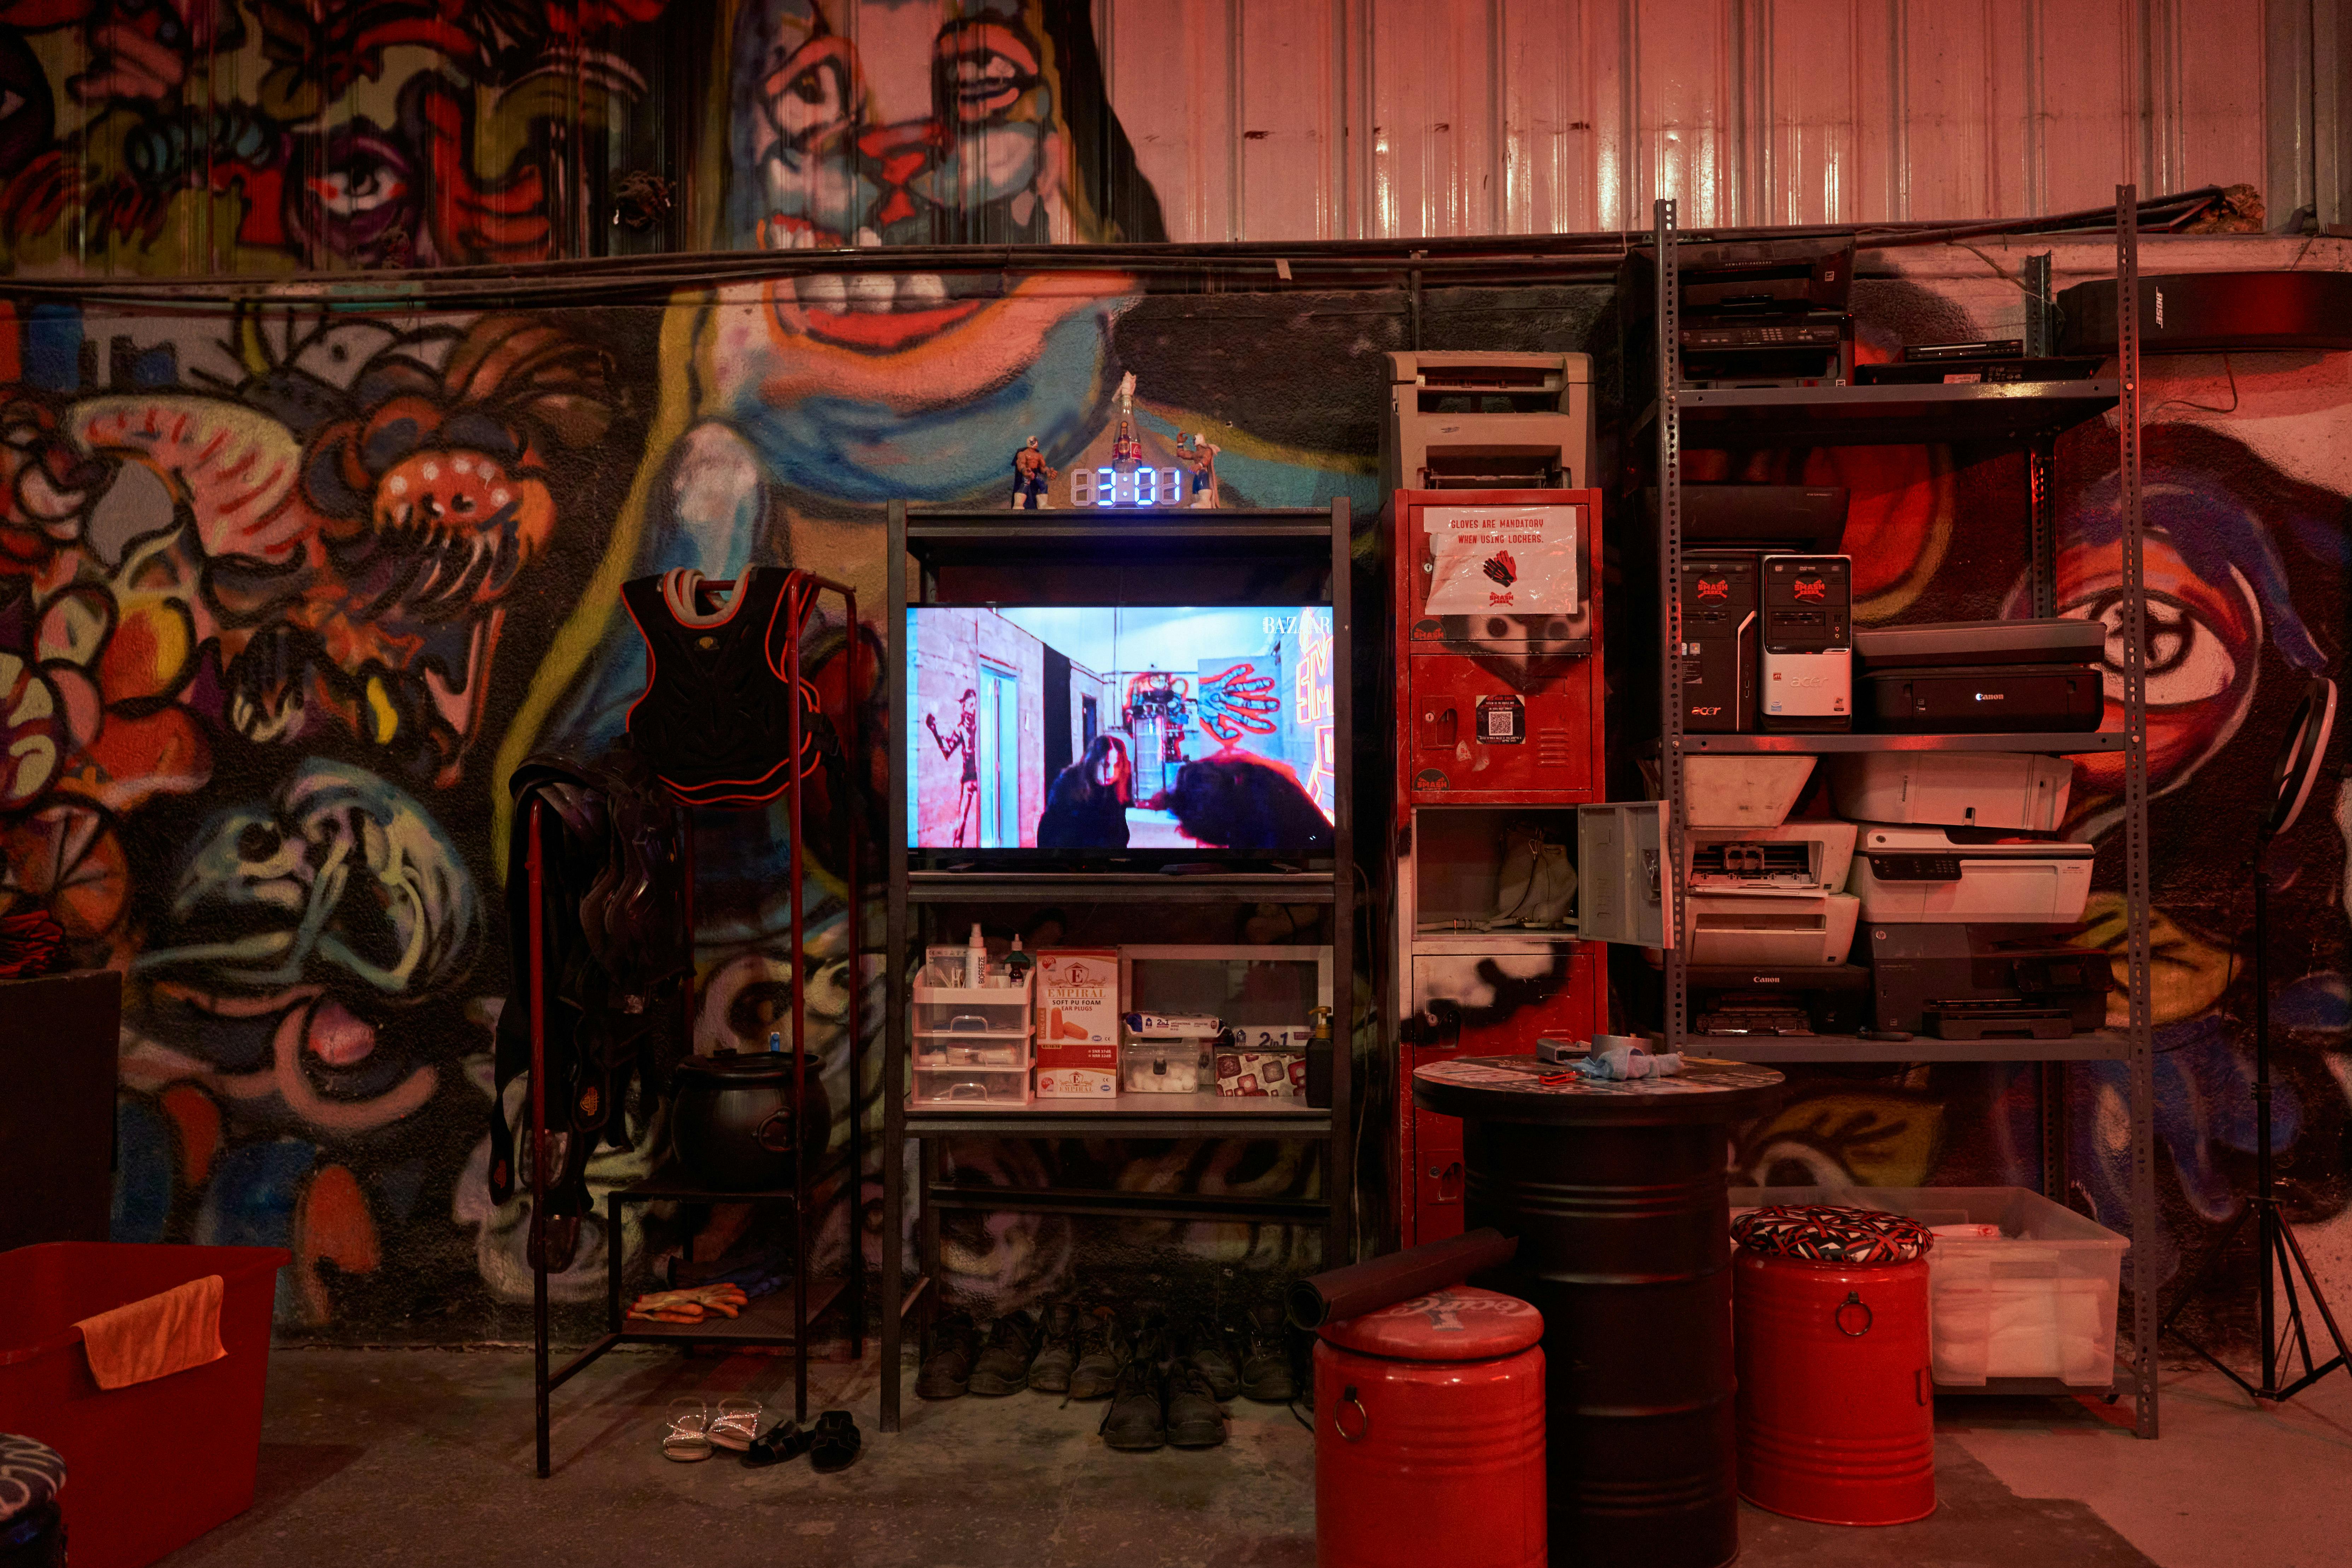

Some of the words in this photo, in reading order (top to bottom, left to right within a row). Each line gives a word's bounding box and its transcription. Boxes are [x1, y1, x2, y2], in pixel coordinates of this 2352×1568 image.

[1098, 468, 1180, 506] 3:01
[1451, 520, 1478, 528] GLOVES
[1482, 520, 1495, 528] ARE
[1500, 519, 1543, 527] MANDATORY
[1458, 535, 1477, 543] WHEN
[1481, 535, 1504, 543] USING
[1508, 535, 1543, 543] LOCKERS.
[1791, 677, 1828, 687] acer
[1877, 931, 1885, 939] hp
[1072, 969, 1082, 983] E
[1048, 989, 1106, 997] EMPIRAL
[1073, 1075, 1080, 1084] E
